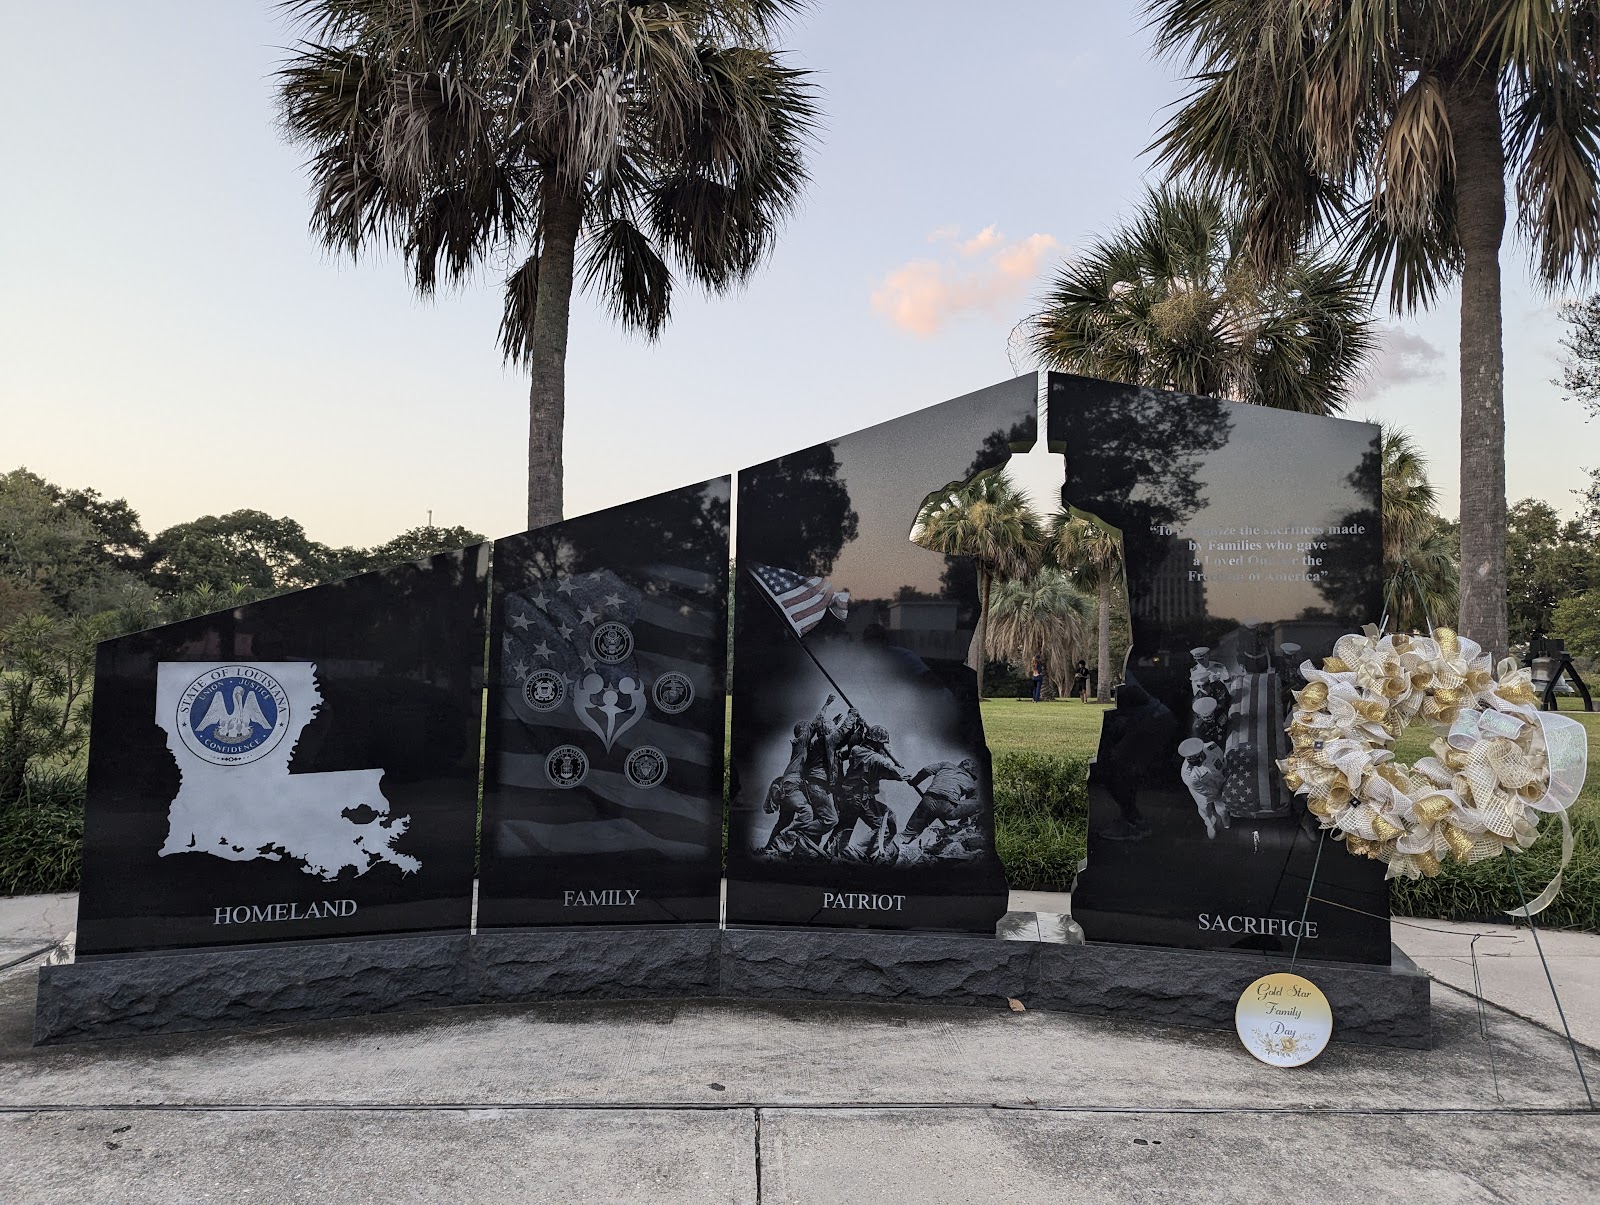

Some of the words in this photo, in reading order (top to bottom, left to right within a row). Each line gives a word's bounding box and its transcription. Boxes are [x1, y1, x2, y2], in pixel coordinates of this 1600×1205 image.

[1240, 525, 1260, 536] the
[1328, 523, 1366, 536] made
[1188, 540, 1203, 554] by
[1208, 539, 1262, 551] Families
[1265, 540, 1293, 551] who
[1297, 541, 1328, 554] gave
[1192, 557, 1201, 567] a
[1302, 555, 1323, 567] the
[180, 679, 207, 714] STATE
[210, 668, 229, 681] OF
[236, 667, 287, 714] LOUISIANA
[198, 681, 225, 701] UNION
[238, 679, 271, 701] JUSTICE
[204, 738, 261, 754] CONFIDENCE
[562, 889, 641, 908] FAMILY
[822, 892, 906, 912] PATRIOT
[213, 899, 358, 926] HOMELAND
[1198, 913, 1319, 939] SACRIFICE
[1257, 982, 1284, 1001] Gold
[1286, 984, 1312, 999] Star
[1264, 1001, 1302, 1019] Family
[1269, 1020, 1298, 1039] Day
